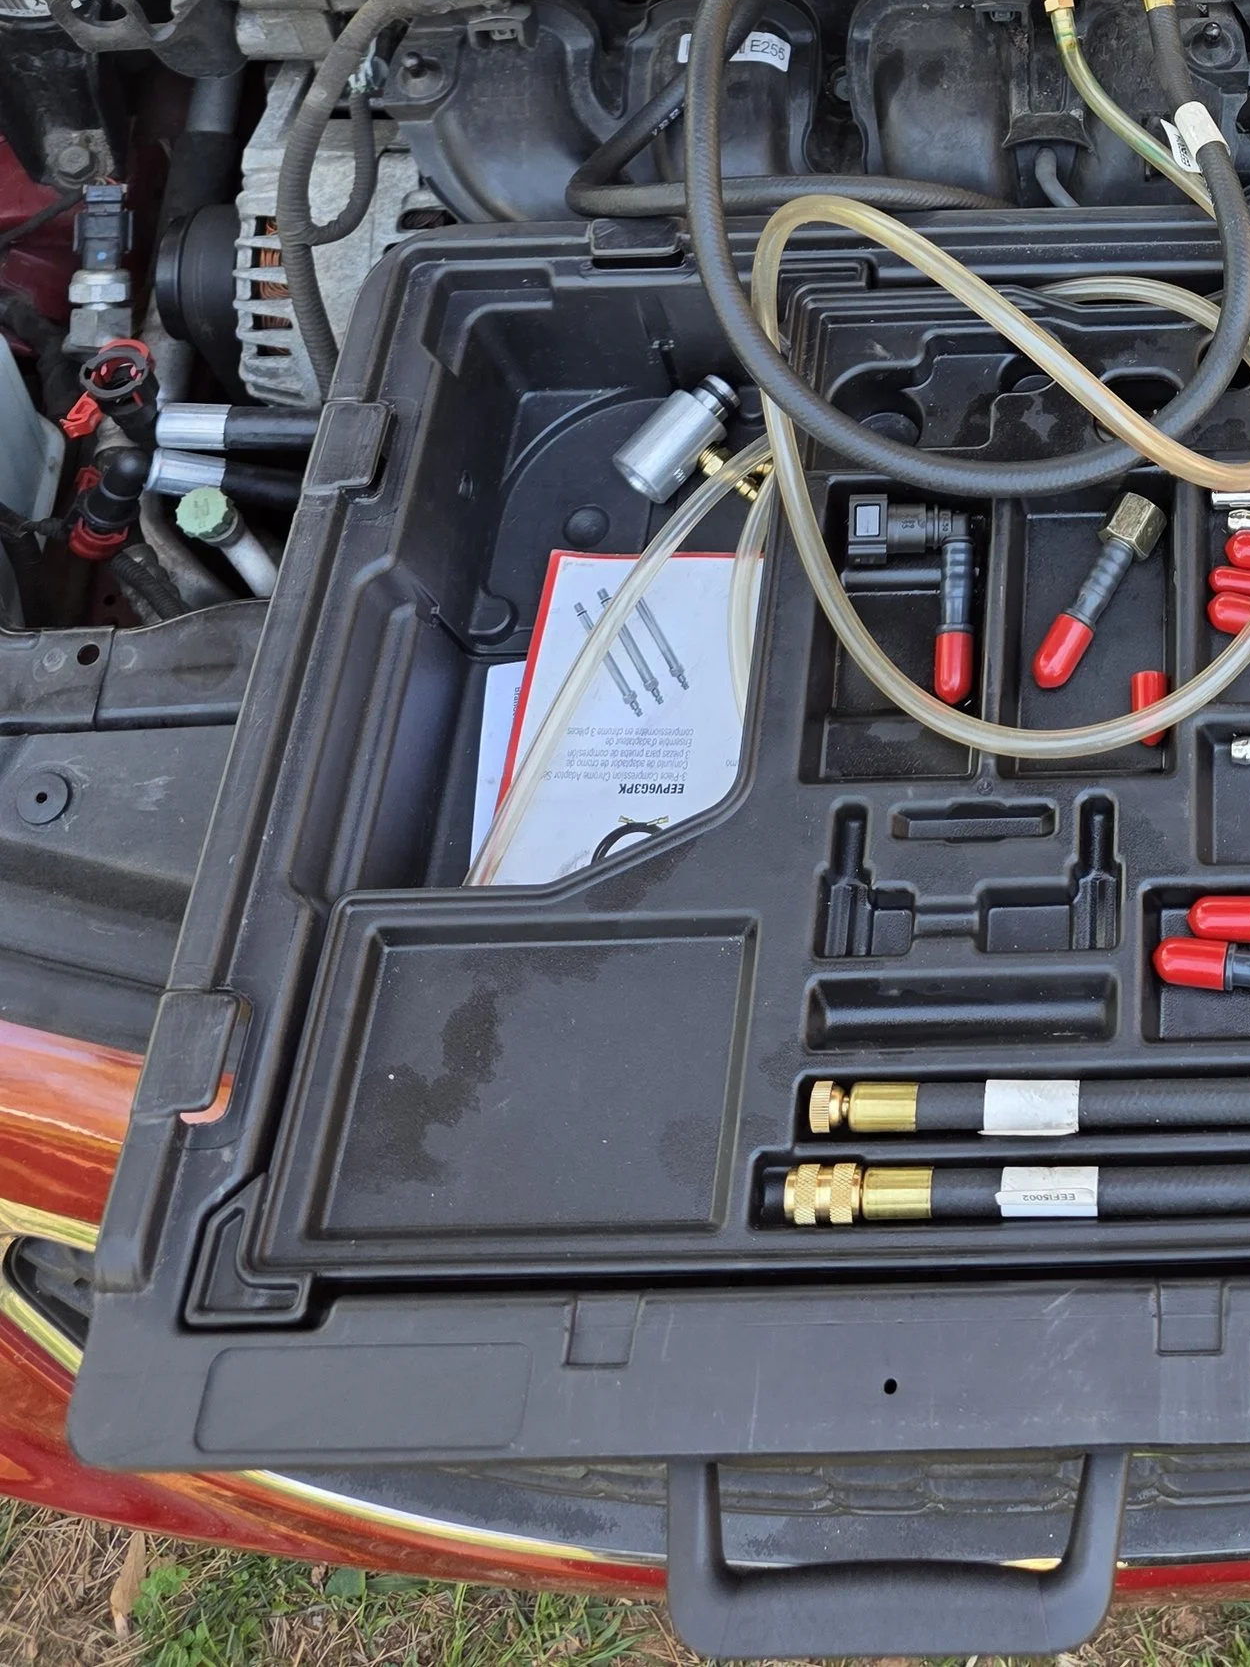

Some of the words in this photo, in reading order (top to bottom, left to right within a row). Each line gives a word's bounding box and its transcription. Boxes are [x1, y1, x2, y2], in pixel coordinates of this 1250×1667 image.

[750, 39, 786, 60] E255
[583, 773, 611, 781] Chrome
[612, 771, 659, 781] Compression
[659, 772, 686, 781] 3-Piece
[618, 784, 684, 794] EEPV6G3PK
